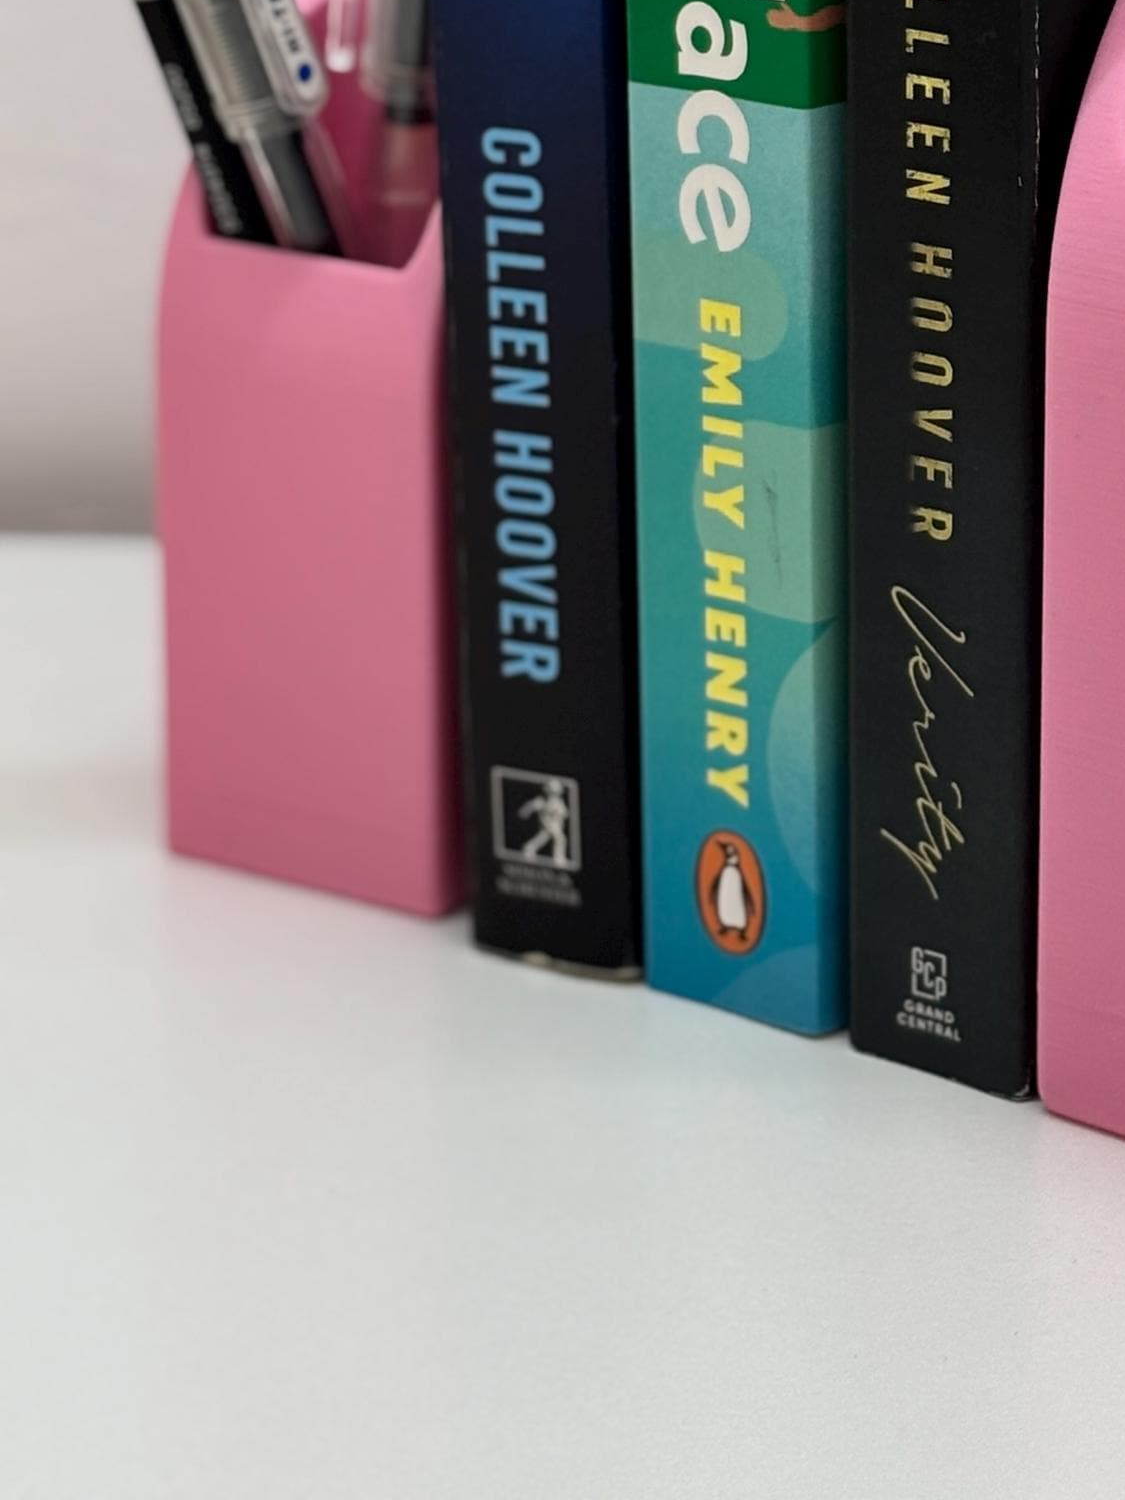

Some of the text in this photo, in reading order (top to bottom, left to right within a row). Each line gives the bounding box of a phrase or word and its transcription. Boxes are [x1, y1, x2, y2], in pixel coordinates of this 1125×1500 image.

[480, 126, 561, 685] COLLEEN HOOVER
[909, 242, 954, 543] HOOVER
[700, 296, 749, 810] EMILY HENRY
[880, 585, 974, 900] Verity
[896, 1011, 961, 1042] CENTRAL
[903, 999, 955, 1024] GRAND
